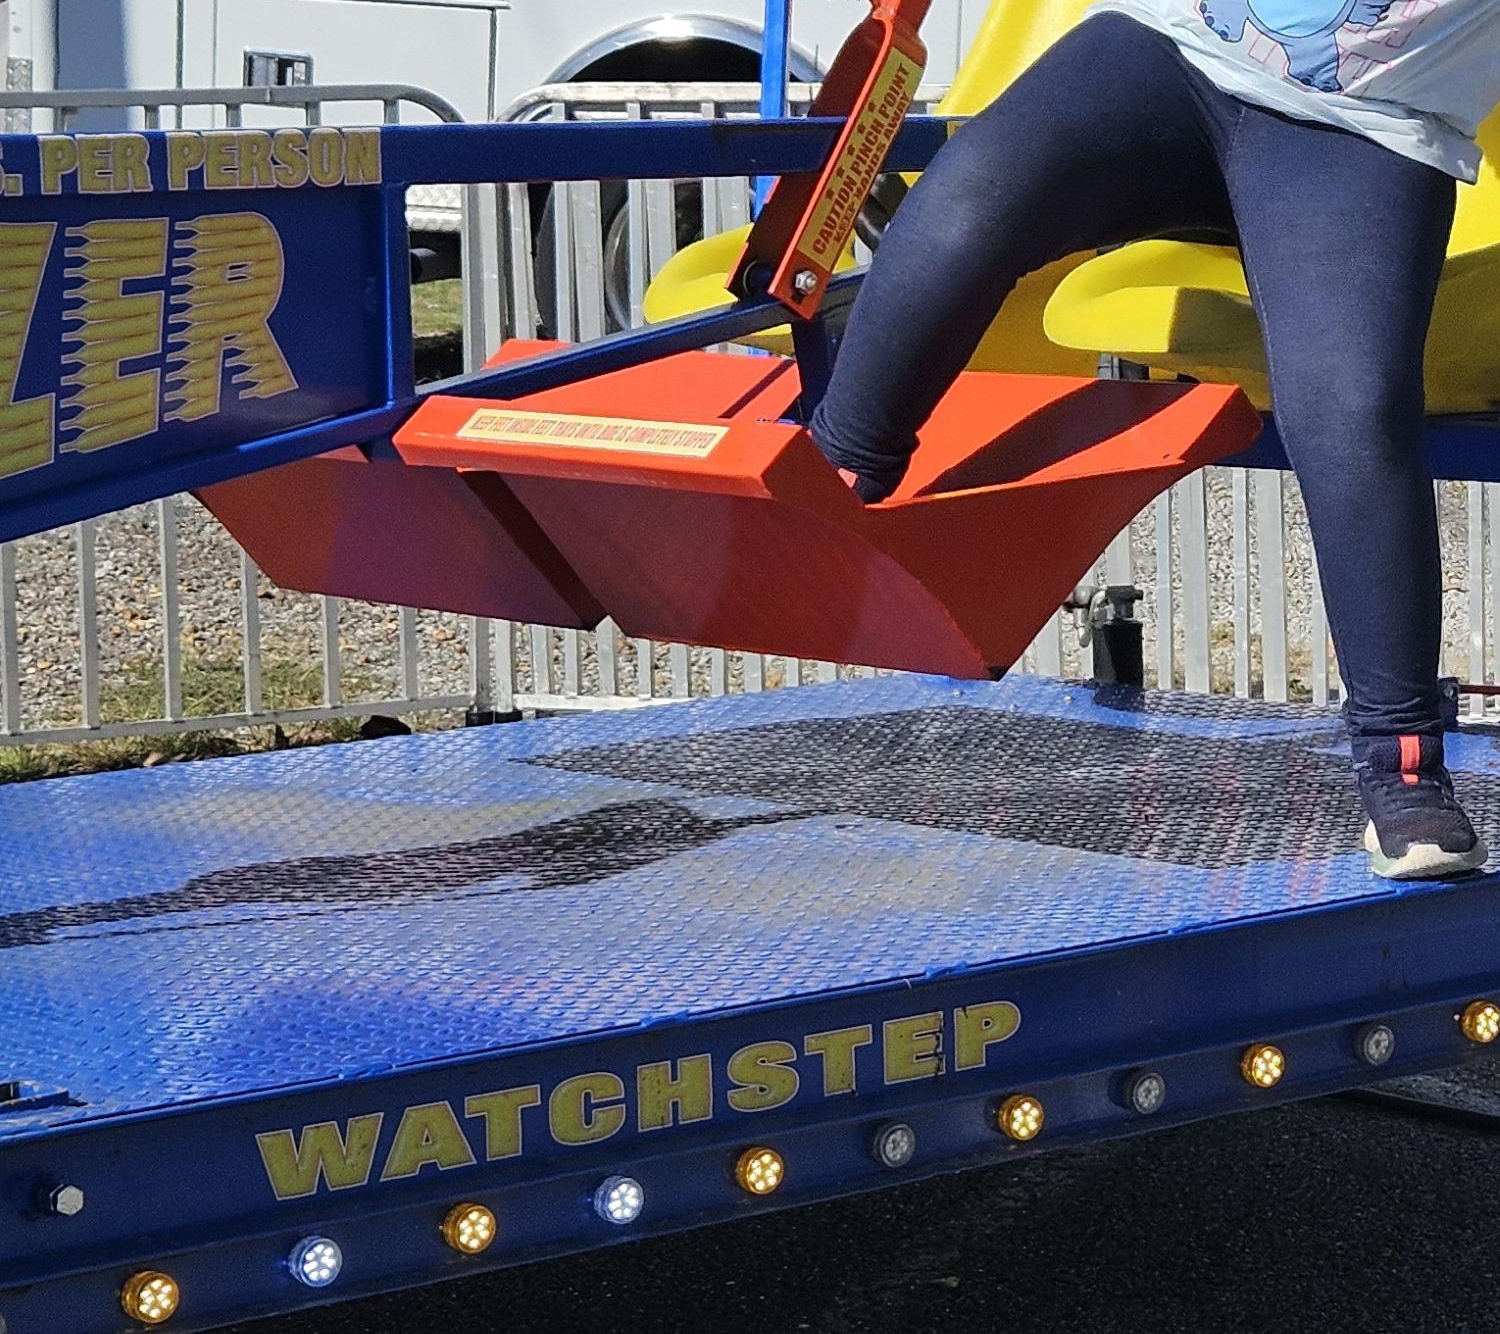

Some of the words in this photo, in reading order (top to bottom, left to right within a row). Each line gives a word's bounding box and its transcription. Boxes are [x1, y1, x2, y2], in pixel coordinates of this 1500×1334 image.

[37, 133, 153, 195] PER
[165, 127, 382, 191] PERSON
[812, 174, 858, 255] CAUTION
[850, 121, 886, 175] PINCH
[878, 62, 911, 116] POINT
[853, 143, 886, 201] HANDS
[882, 91, 910, 143] AWAY
